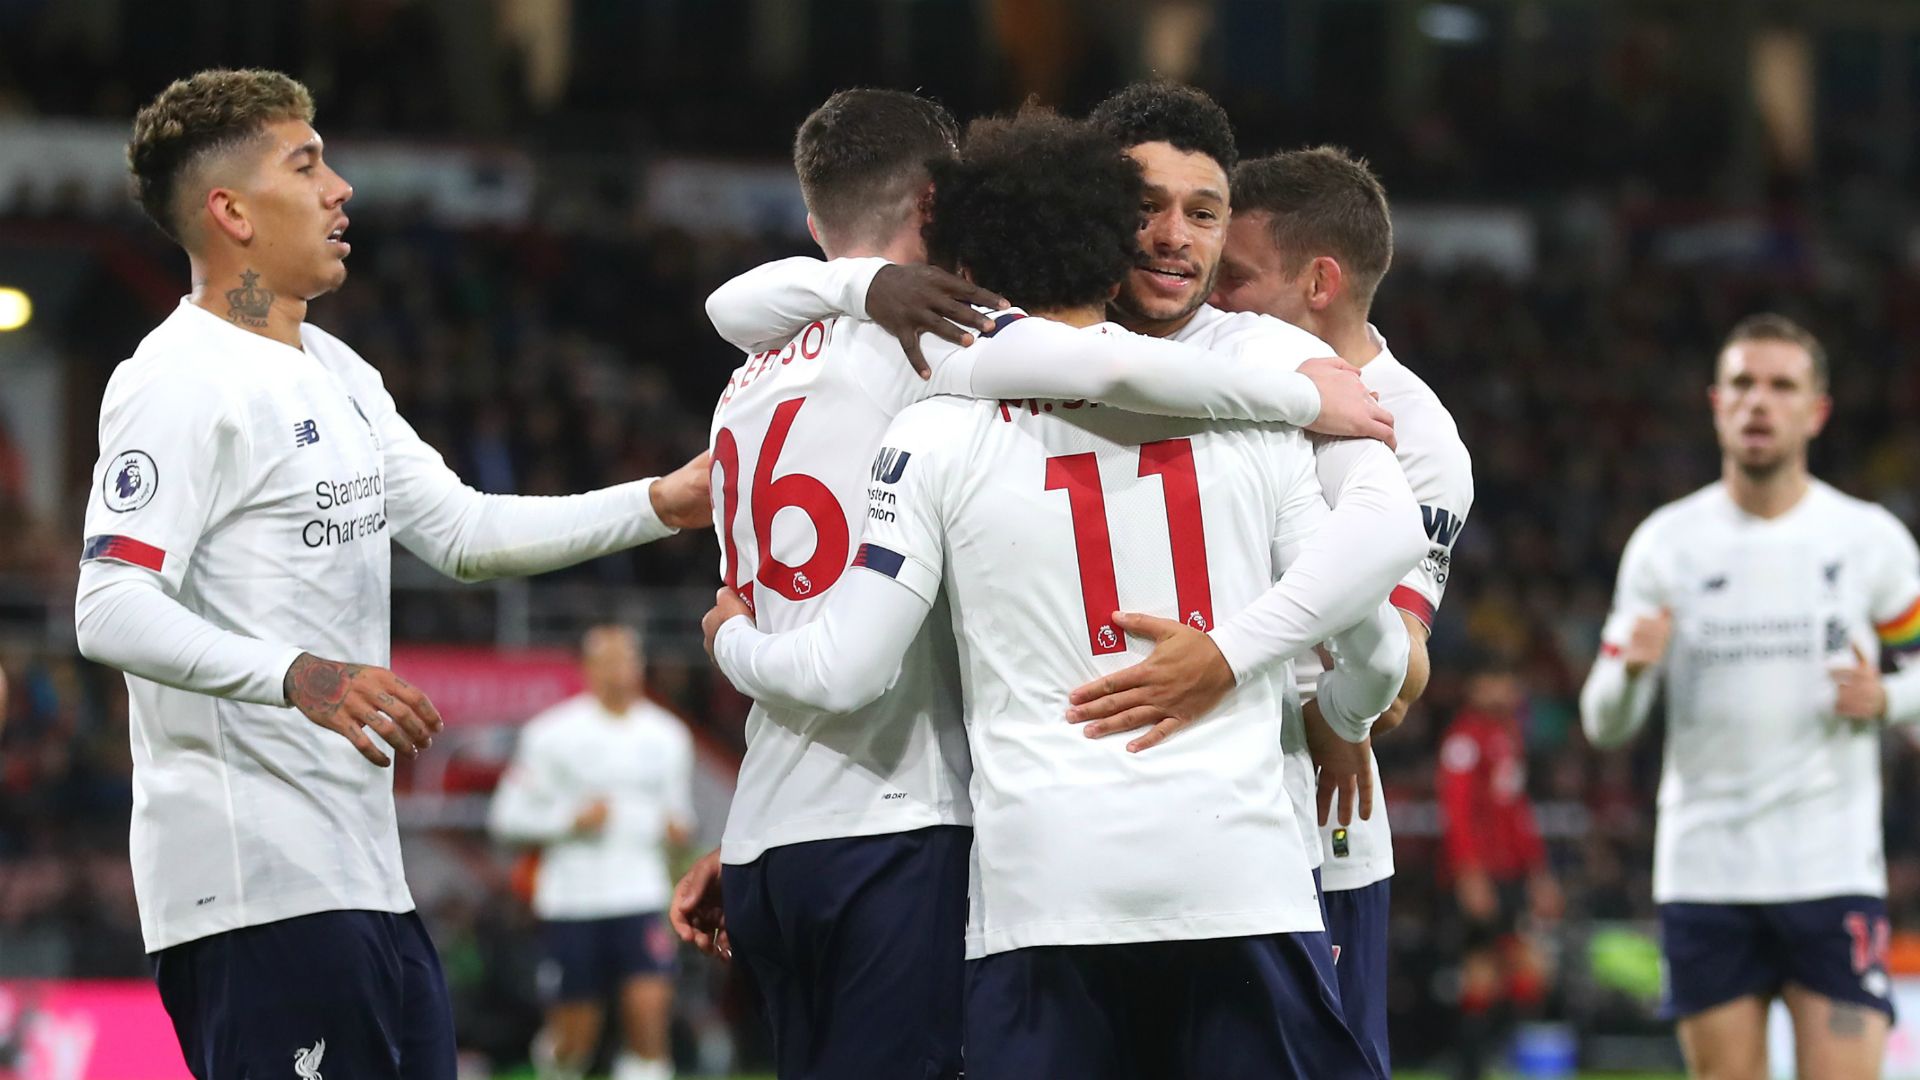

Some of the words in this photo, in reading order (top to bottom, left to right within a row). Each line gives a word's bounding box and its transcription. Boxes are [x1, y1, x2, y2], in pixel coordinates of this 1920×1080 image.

[316, 467, 382, 510] Standard
[868, 487, 896, 505] stern
[709, 396, 850, 628] 26
[868, 502, 895, 523] nion
[1045, 438, 1214, 656] 11
